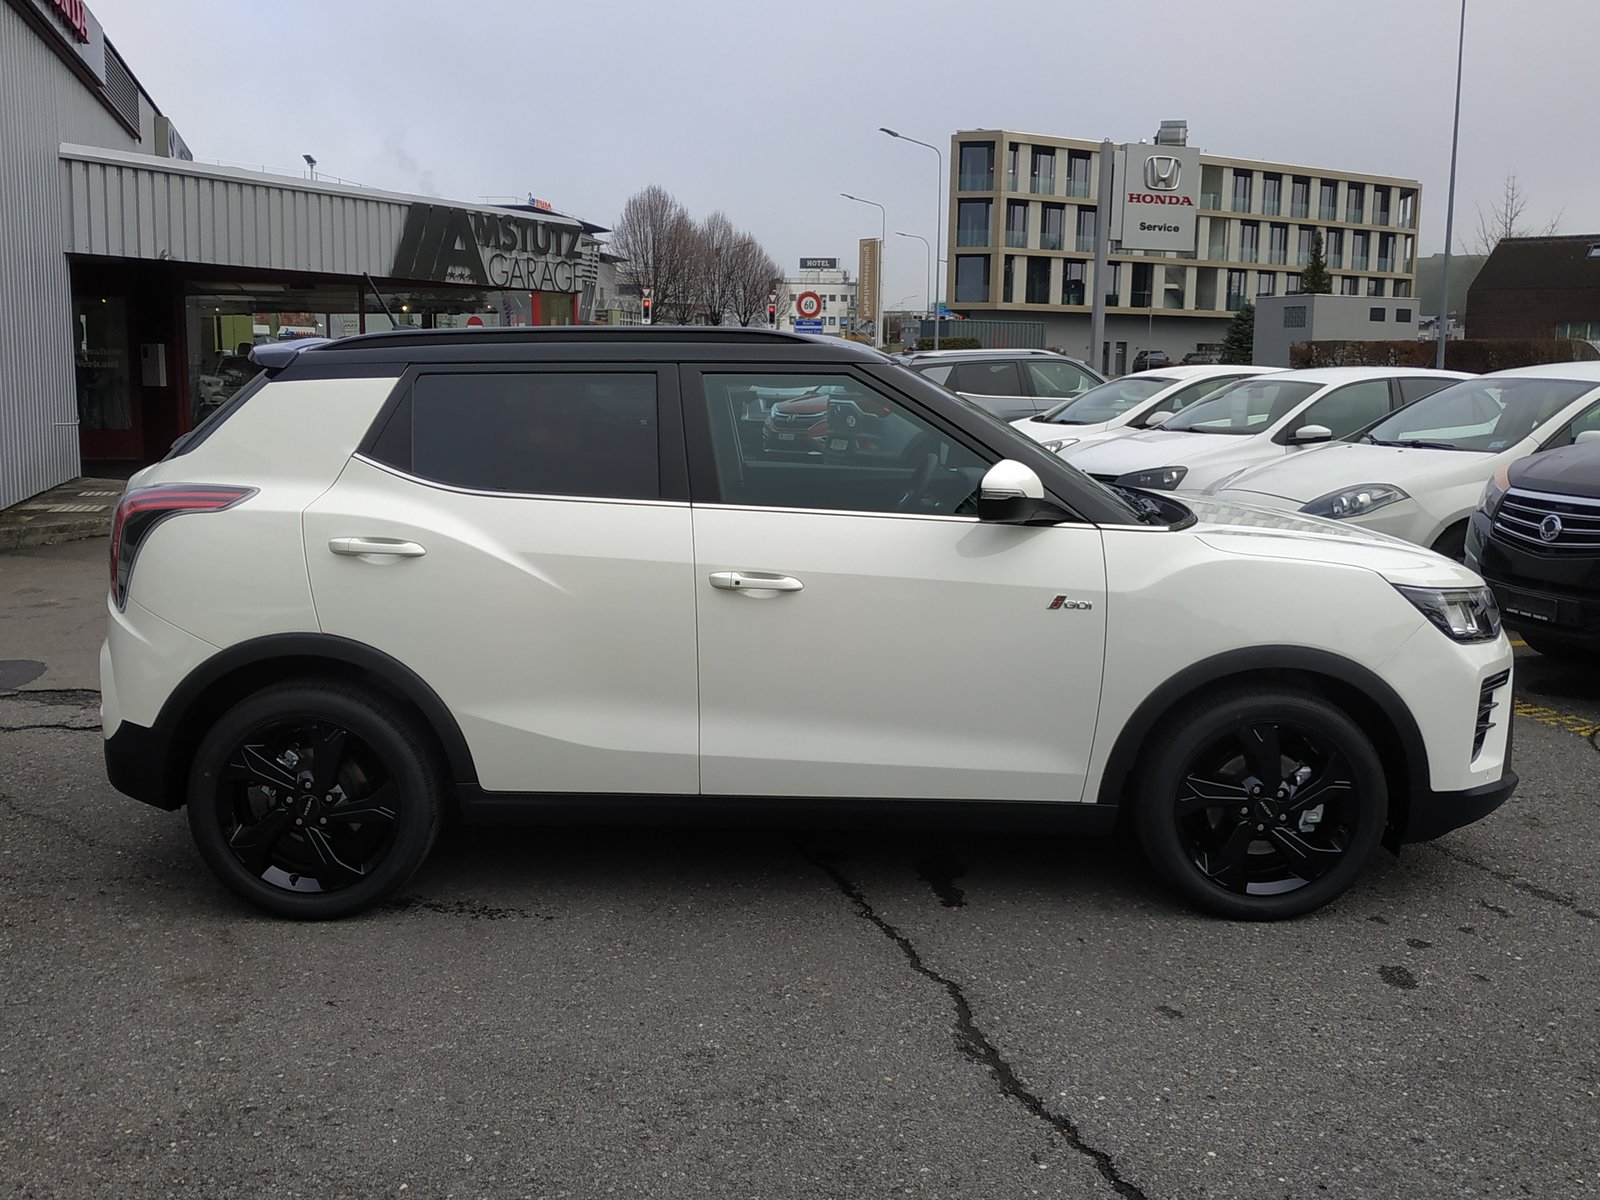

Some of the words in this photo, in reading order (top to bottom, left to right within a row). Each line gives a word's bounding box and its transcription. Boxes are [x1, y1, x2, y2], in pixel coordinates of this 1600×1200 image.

[1128, 193, 1194, 206] HONDA
[1139, 222, 1180, 233] Service
[430, 207, 583, 286] AMSTUTZ
[489, 253, 583, 293] GARAGE
[803, 300, 814, 310] 60
